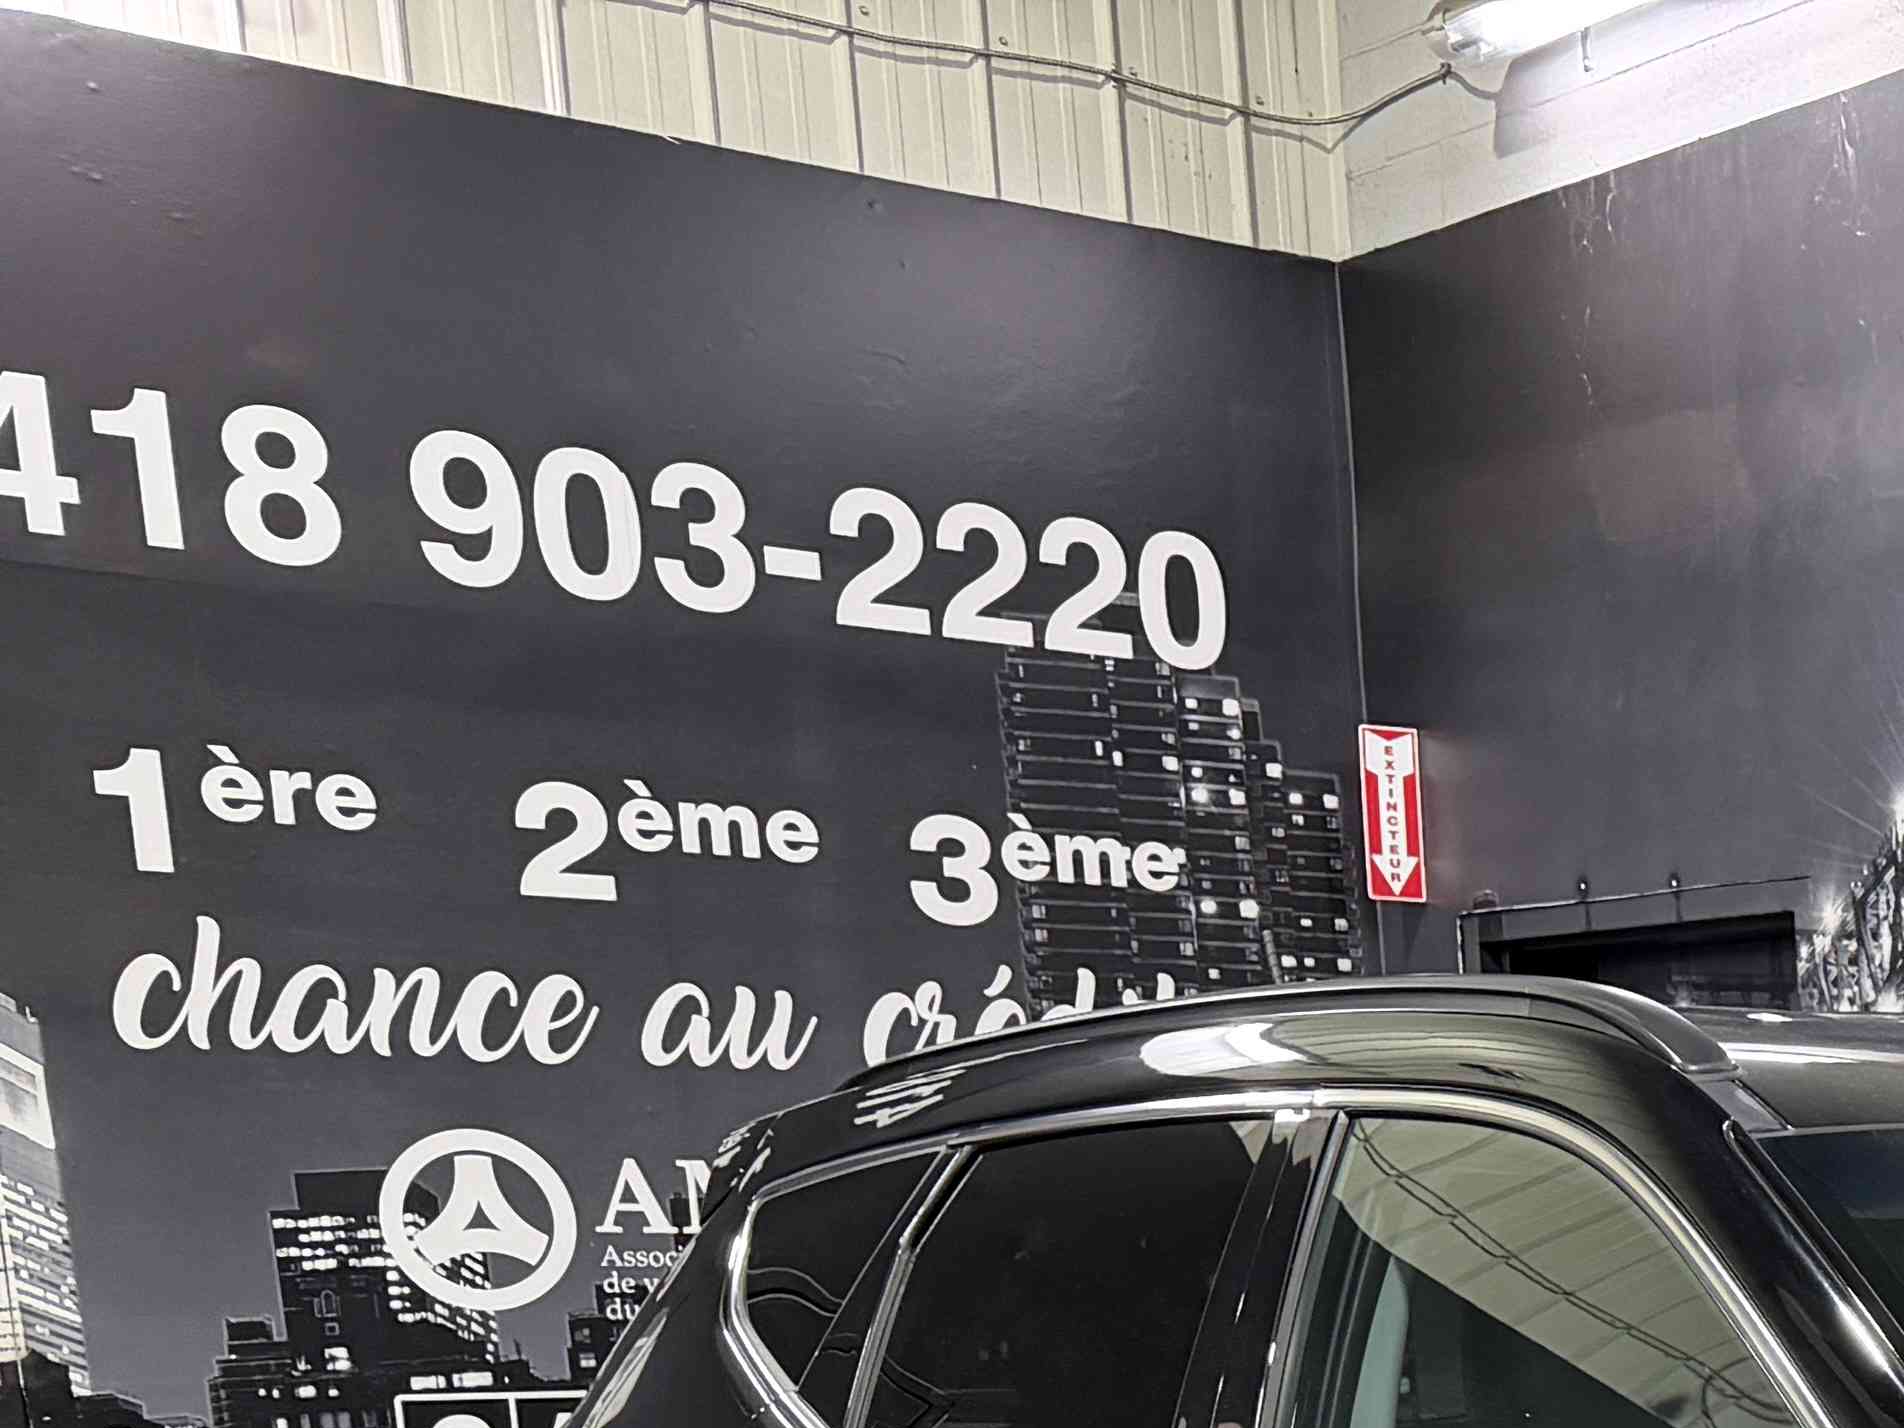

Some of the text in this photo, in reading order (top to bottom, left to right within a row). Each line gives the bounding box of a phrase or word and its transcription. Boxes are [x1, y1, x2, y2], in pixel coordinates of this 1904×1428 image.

[0, 370, 1226, 670] 418 903-2220
[92, 744, 1187, 926] 1ère 2ème 3ème
[1383, 745, 1402, 883] EXTINCTEUR
[112, 915, 600, 1065] chance
[641, 982, 818, 1071] au
[602, 1271, 636, 1294] de
